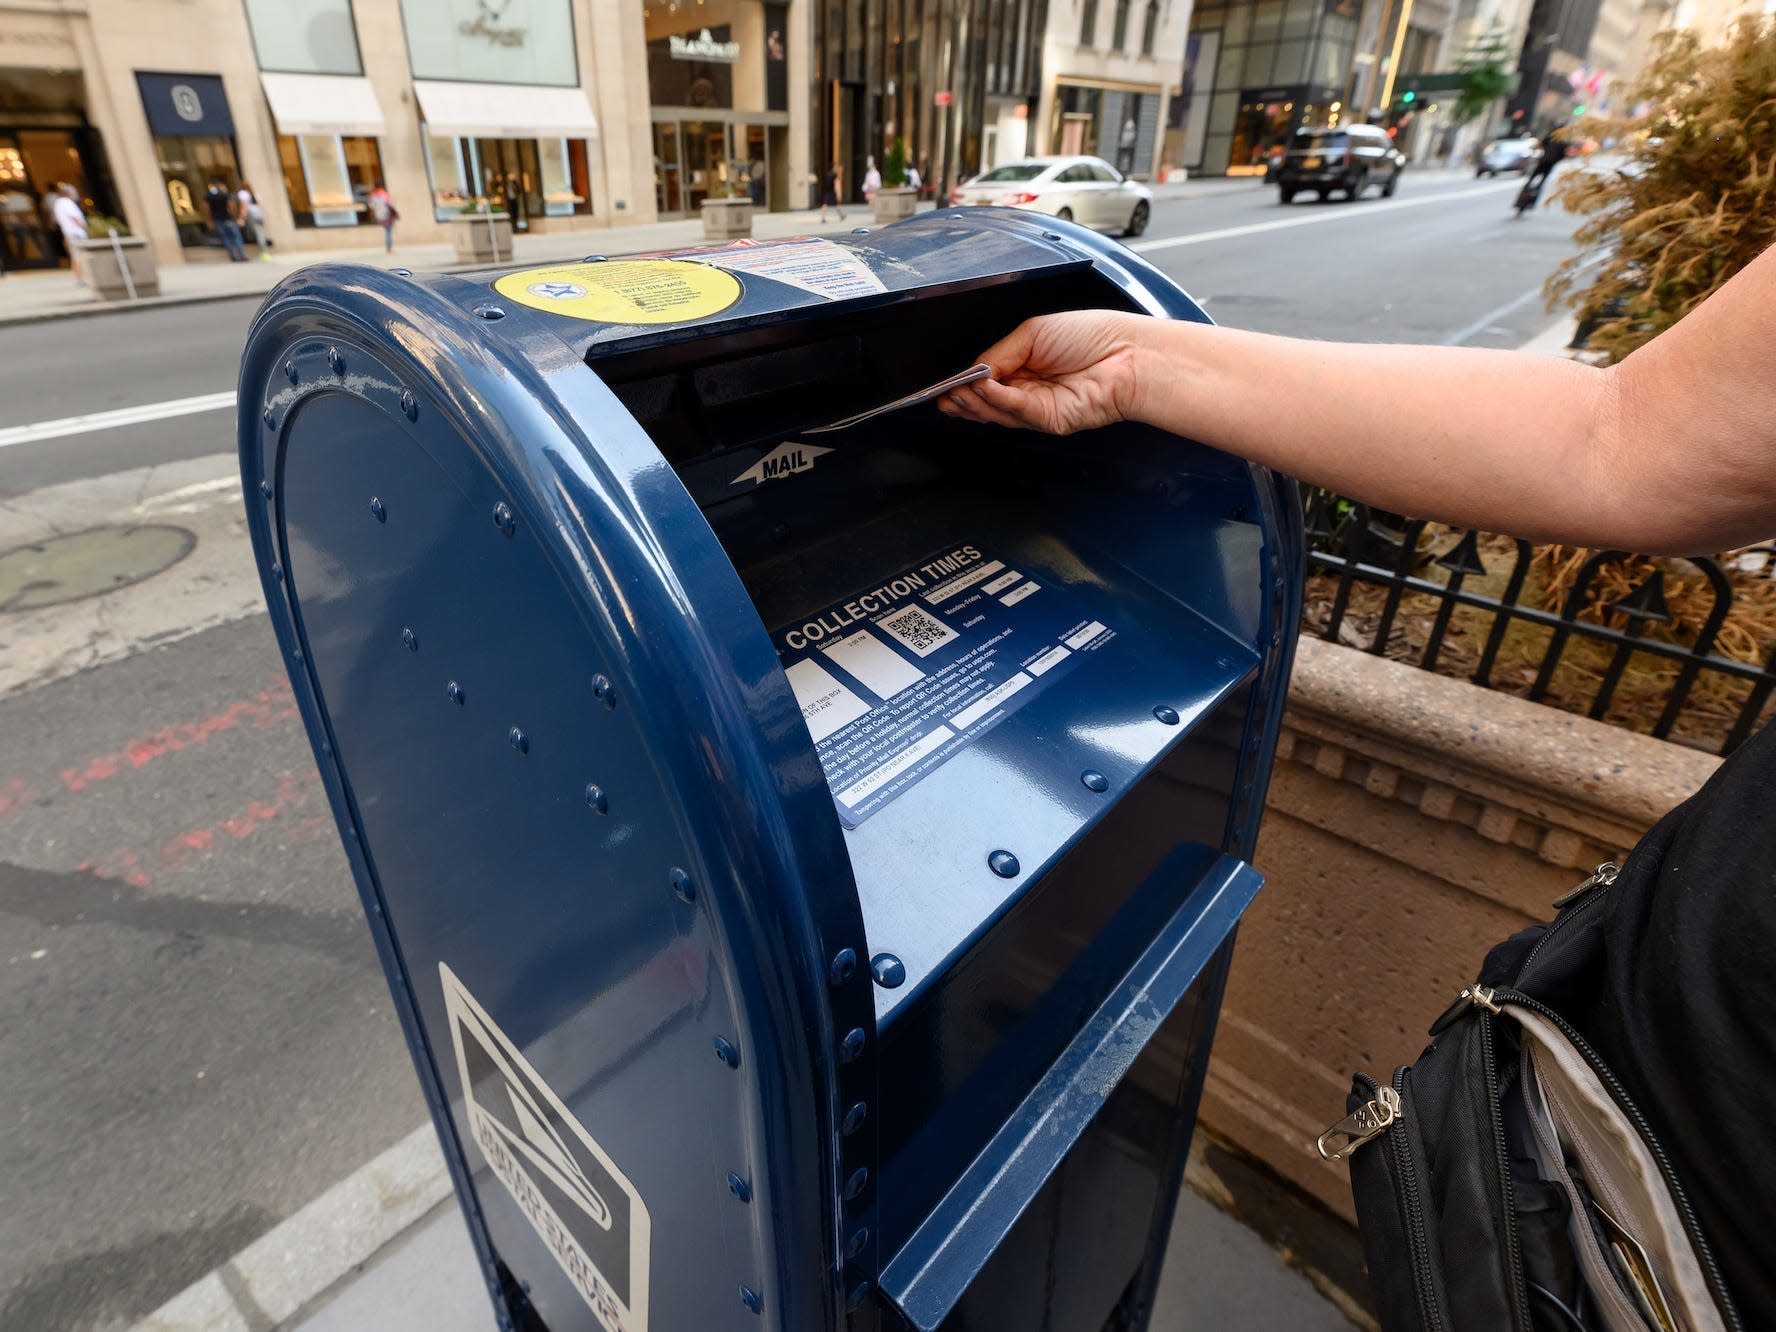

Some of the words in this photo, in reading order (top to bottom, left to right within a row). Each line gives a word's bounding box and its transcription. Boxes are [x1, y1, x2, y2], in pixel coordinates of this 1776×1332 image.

[762, 450, 808, 478] MAIL
[786, 573, 926, 650] COLLECTION
[920, 545, 982, 580] TIMES
[869, 614, 884, 622] Scan
[882, 607, 896, 615] here
[963, 615, 985, 627] Saturday
[816, 635, 843, 650] Saturday
[1020, 655, 1037, 666] Location
[816, 696, 830, 704] THIS
[828, 689, 841, 697] BOX
[819, 740, 832, 748] the
[831, 724, 856, 741] nearest
[854, 715, 871, 726] Post
[890, 689, 915, 704] location
[913, 681, 927, 690] with
[935, 663, 959, 677] address,
[956, 654, 972, 664] hours
[977, 635, 1004, 652] operations,
[1002, 628, 1012, 636] and
[808, 708, 820, 716] 5TH
[820, 701, 832, 709] AVE
[824, 762, 837, 770] the
[836, 753, 850, 763] day
[848, 740, 870, 755] before
[874, 722, 900, 738] holiday,
[898, 708, 919, 724] normal
[918, 692, 945, 710] collection
[943, 683, 960, 694] times
[959, 675, 972, 684] may
[970, 669, 981, 677] not
[835, 739, 852, 751] scan
[851, 732, 863, 740] the
[862, 724, 874, 733] QR
[872, 715, 892, 727] Code.
[899, 698, 918, 711] report
[916, 691, 927, 699] QR
[925, 683, 942, 694] Code
[939, 672, 961, 685] issues,
[950, 704, 962, 713] local
[843, 759, 860, 770] with
[858, 750, 874, 762] your
[872, 739, 890, 751] local
[889, 718, 922, 742] postmaster
[928, 704, 945, 715] verify
[944, 687, 970, 705] collection
[968, 678, 985, 689] times.
[858, 760, 879, 774] Priority
[877, 753, 890, 762] Mail
[855, 798, 881, 815] Tampering
[879, 791, 890, 799] with
[888, 784, 898, 792] this
[922, 755, 940, 768] contents
[543, 1208, 621, 1321] STATES
